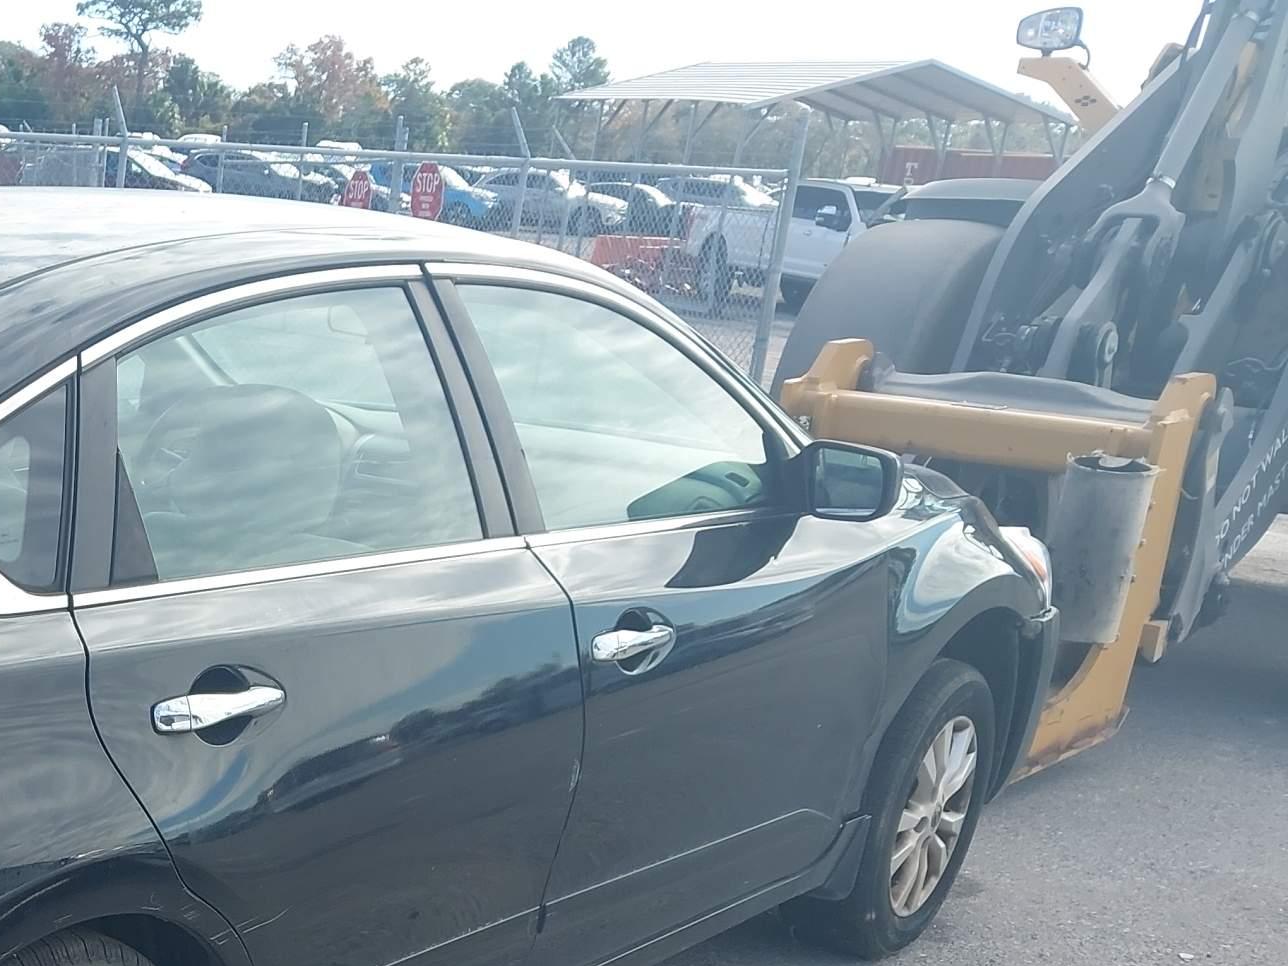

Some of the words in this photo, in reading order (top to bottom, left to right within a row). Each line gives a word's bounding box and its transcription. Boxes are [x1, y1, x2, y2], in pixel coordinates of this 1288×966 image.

[348, 180, 368, 199] STOP
[417, 173, 440, 193] STOP
[1233, 464, 1260, 521] NOT
[1222, 513, 1255, 569] NDER
